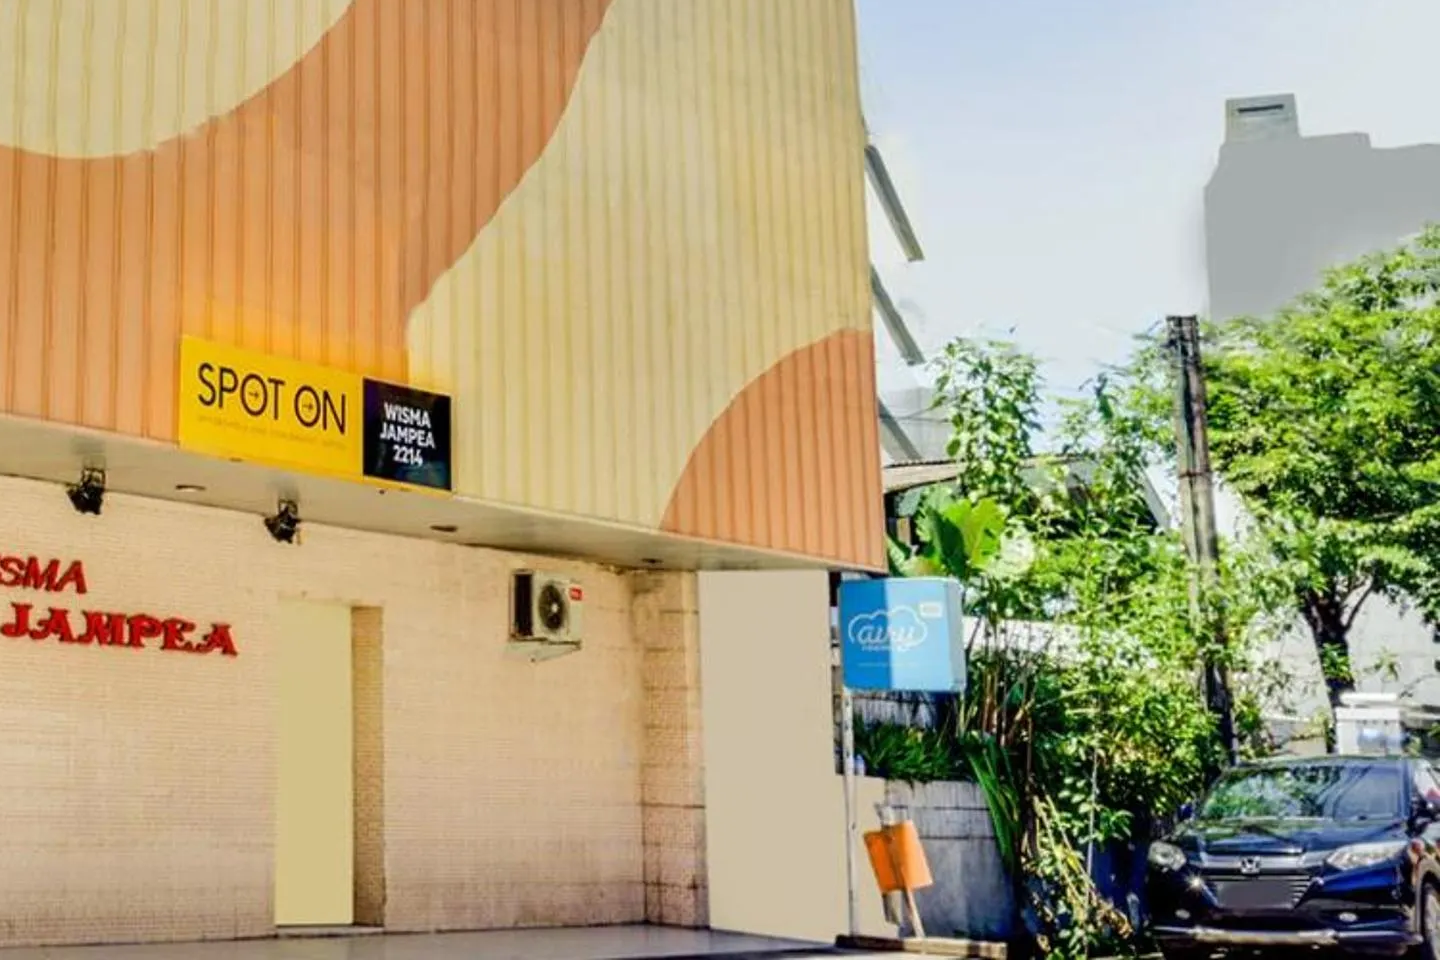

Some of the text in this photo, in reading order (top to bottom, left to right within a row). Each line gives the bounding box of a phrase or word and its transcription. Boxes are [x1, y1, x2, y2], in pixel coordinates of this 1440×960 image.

[198, 362, 286, 420] SPOT
[294, 385, 346, 435] ON
[383, 402, 432, 428] WISMA
[380, 422, 435, 449] JAMPEA
[392, 445, 423, 467] 2214
[0, 601, 238, 657] JAMPEA
